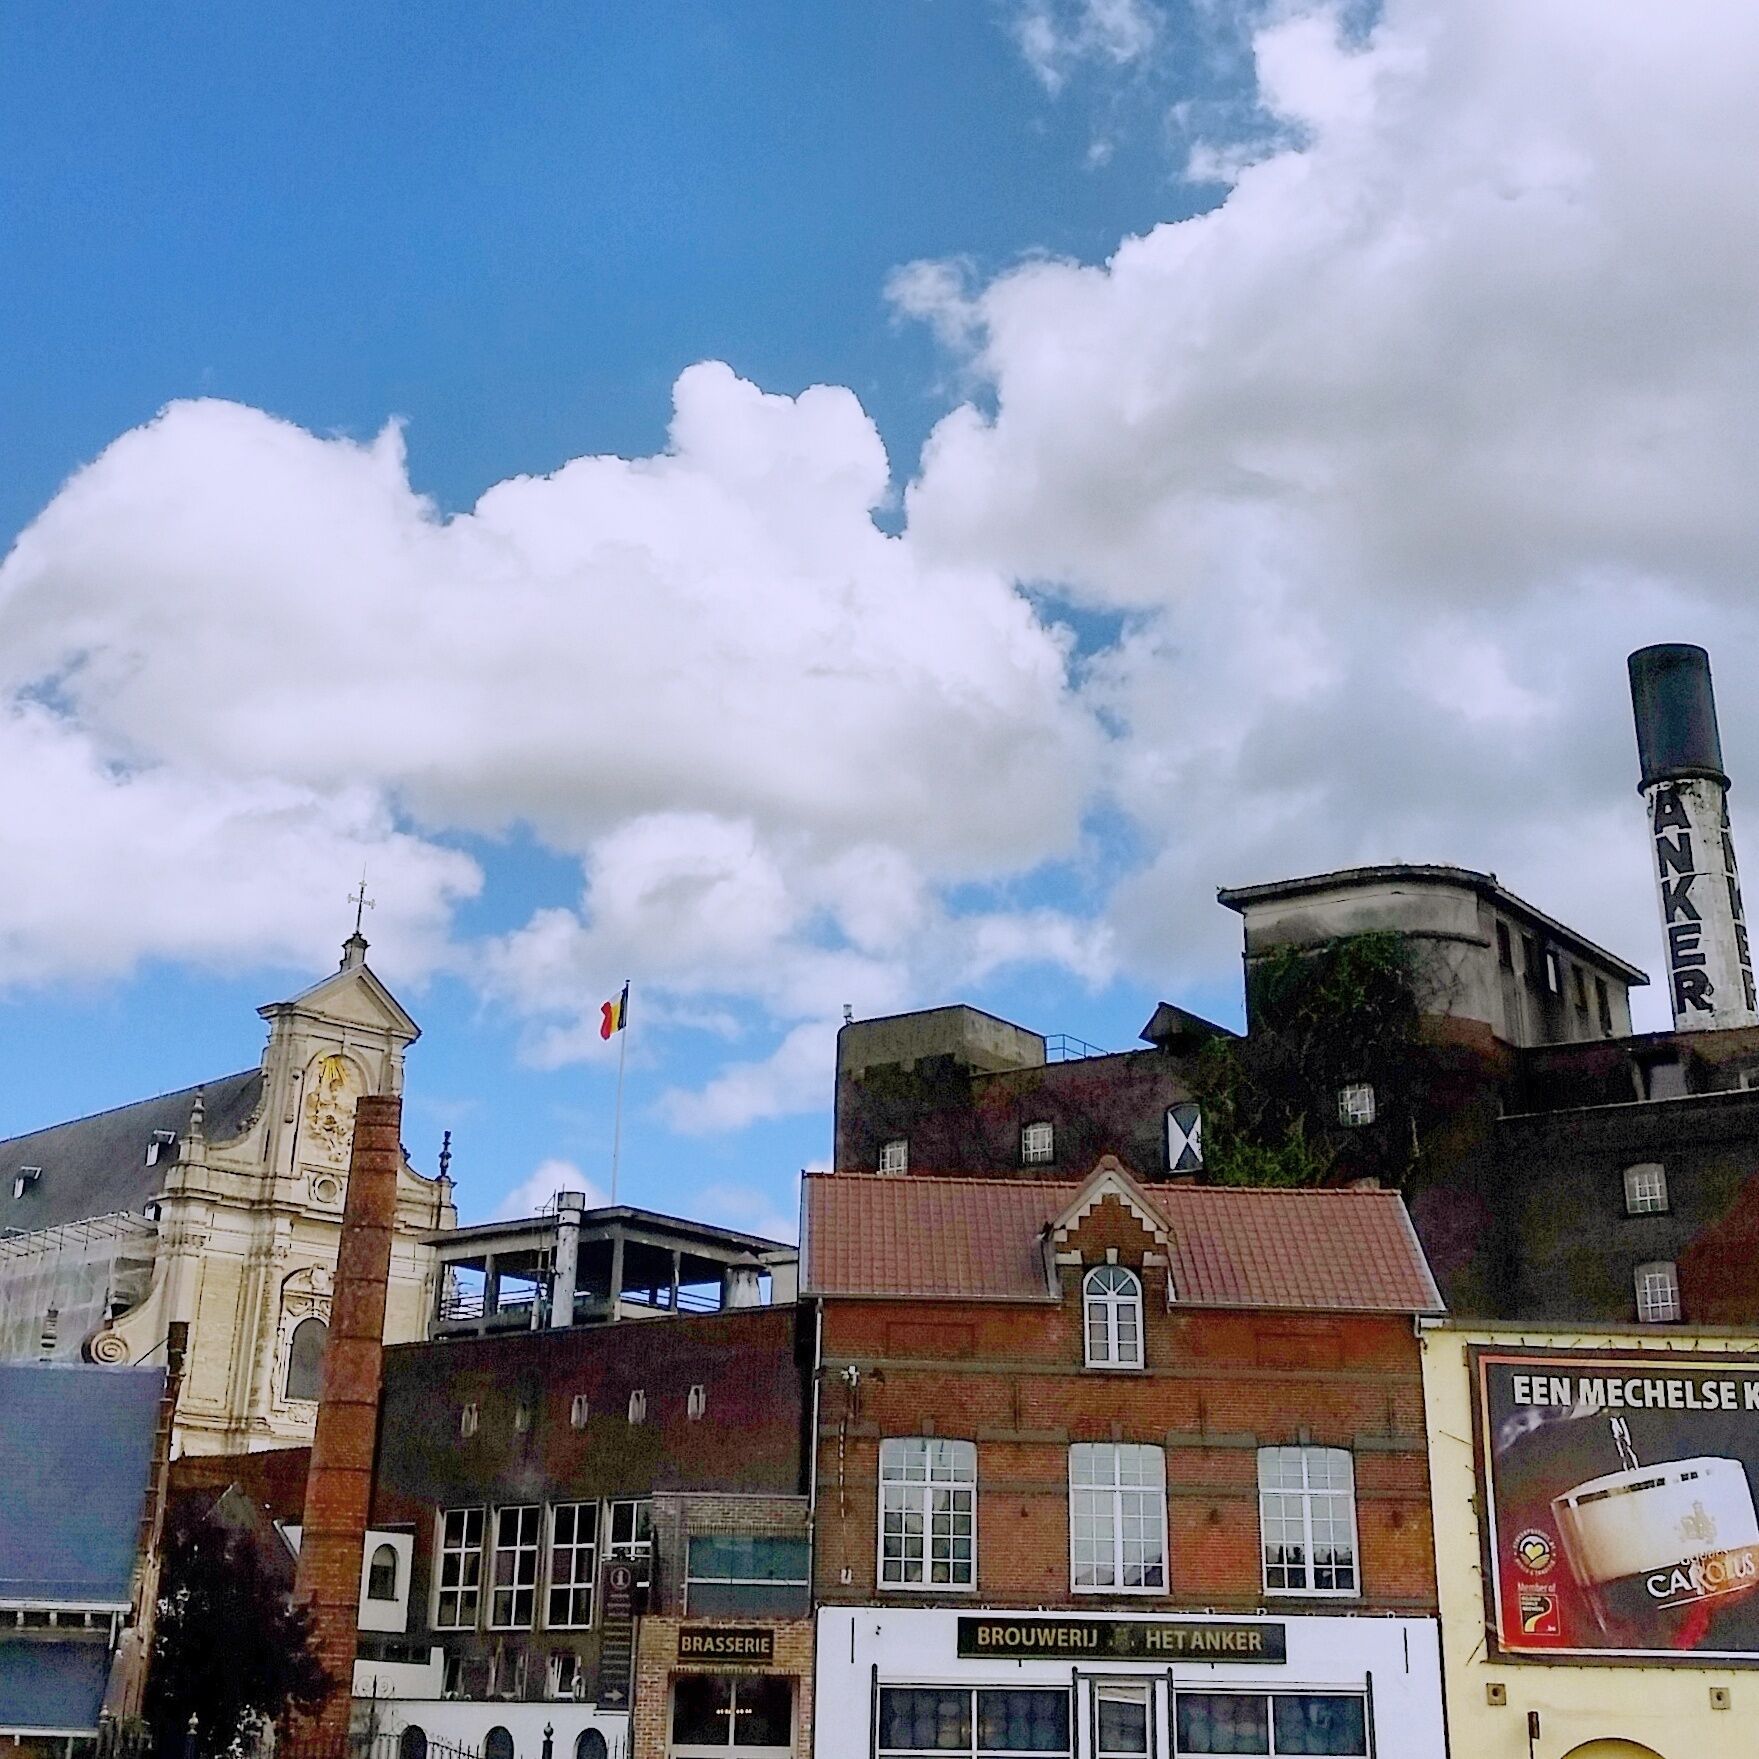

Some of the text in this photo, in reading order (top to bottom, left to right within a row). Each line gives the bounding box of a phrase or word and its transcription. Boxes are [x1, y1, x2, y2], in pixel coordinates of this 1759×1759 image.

[1653, 789, 1714, 1014] ANKER
[1513, 1375, 1571, 1406] EEN
[1578, 1378, 1738, 1410] MECHELSE
[681, 1636, 771, 1653] BRASSERIE
[977, 1626, 1262, 1651] BROUWERIJ HET ANKER
